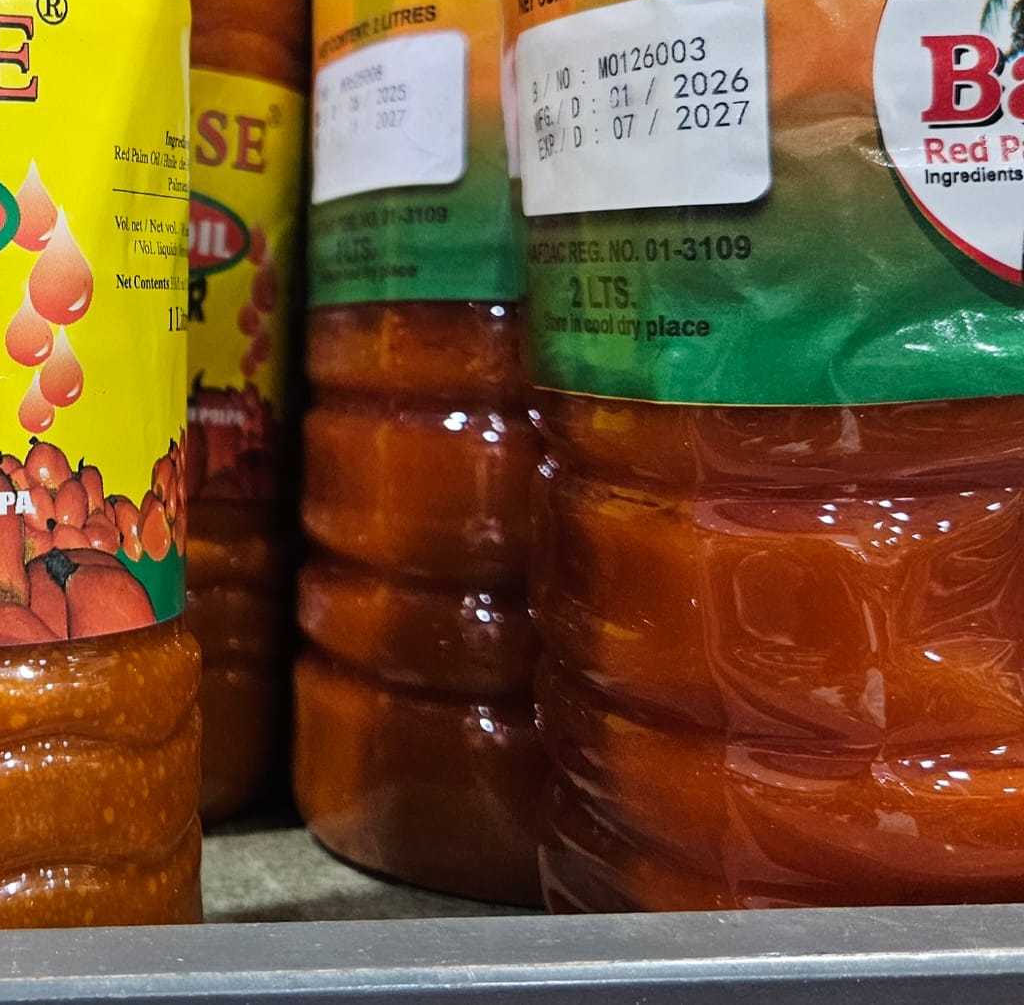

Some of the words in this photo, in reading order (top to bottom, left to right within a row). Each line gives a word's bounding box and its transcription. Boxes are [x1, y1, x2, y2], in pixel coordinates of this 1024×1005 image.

[382, 4, 437, 30] LITRES
[556, 67, 571, 91] NO
[673, 67, 750, 99] 2026
[612, 113, 636, 141] 07
[675, 100, 751, 132] 2027
[114, 145, 131, 162] Red
[131, 147, 149, 164] Palm
[923, 133, 989, 165] Red
[924, 165, 1024, 188] Ingredients
[115, 215, 130, 231] Vol.
[131, 220, 143, 232] net
[150, 218, 164, 233] Net
[138, 239, 156, 255] Vol.
[568, 239, 605, 264] REG.
[608, 238, 640, 264] NO.
[644, 234, 752, 262] 01-3109
[116, 274, 132, 289] Net
[133, 274, 170, 290] Contents
[569, 276, 583, 309] 2
[587, 274, 638, 309] LTS.
[569, 314, 581, 334] in
[583, 314, 614, 335] cool
[617, 314, 641, 341] dry
[645, 314, 711, 344] place
